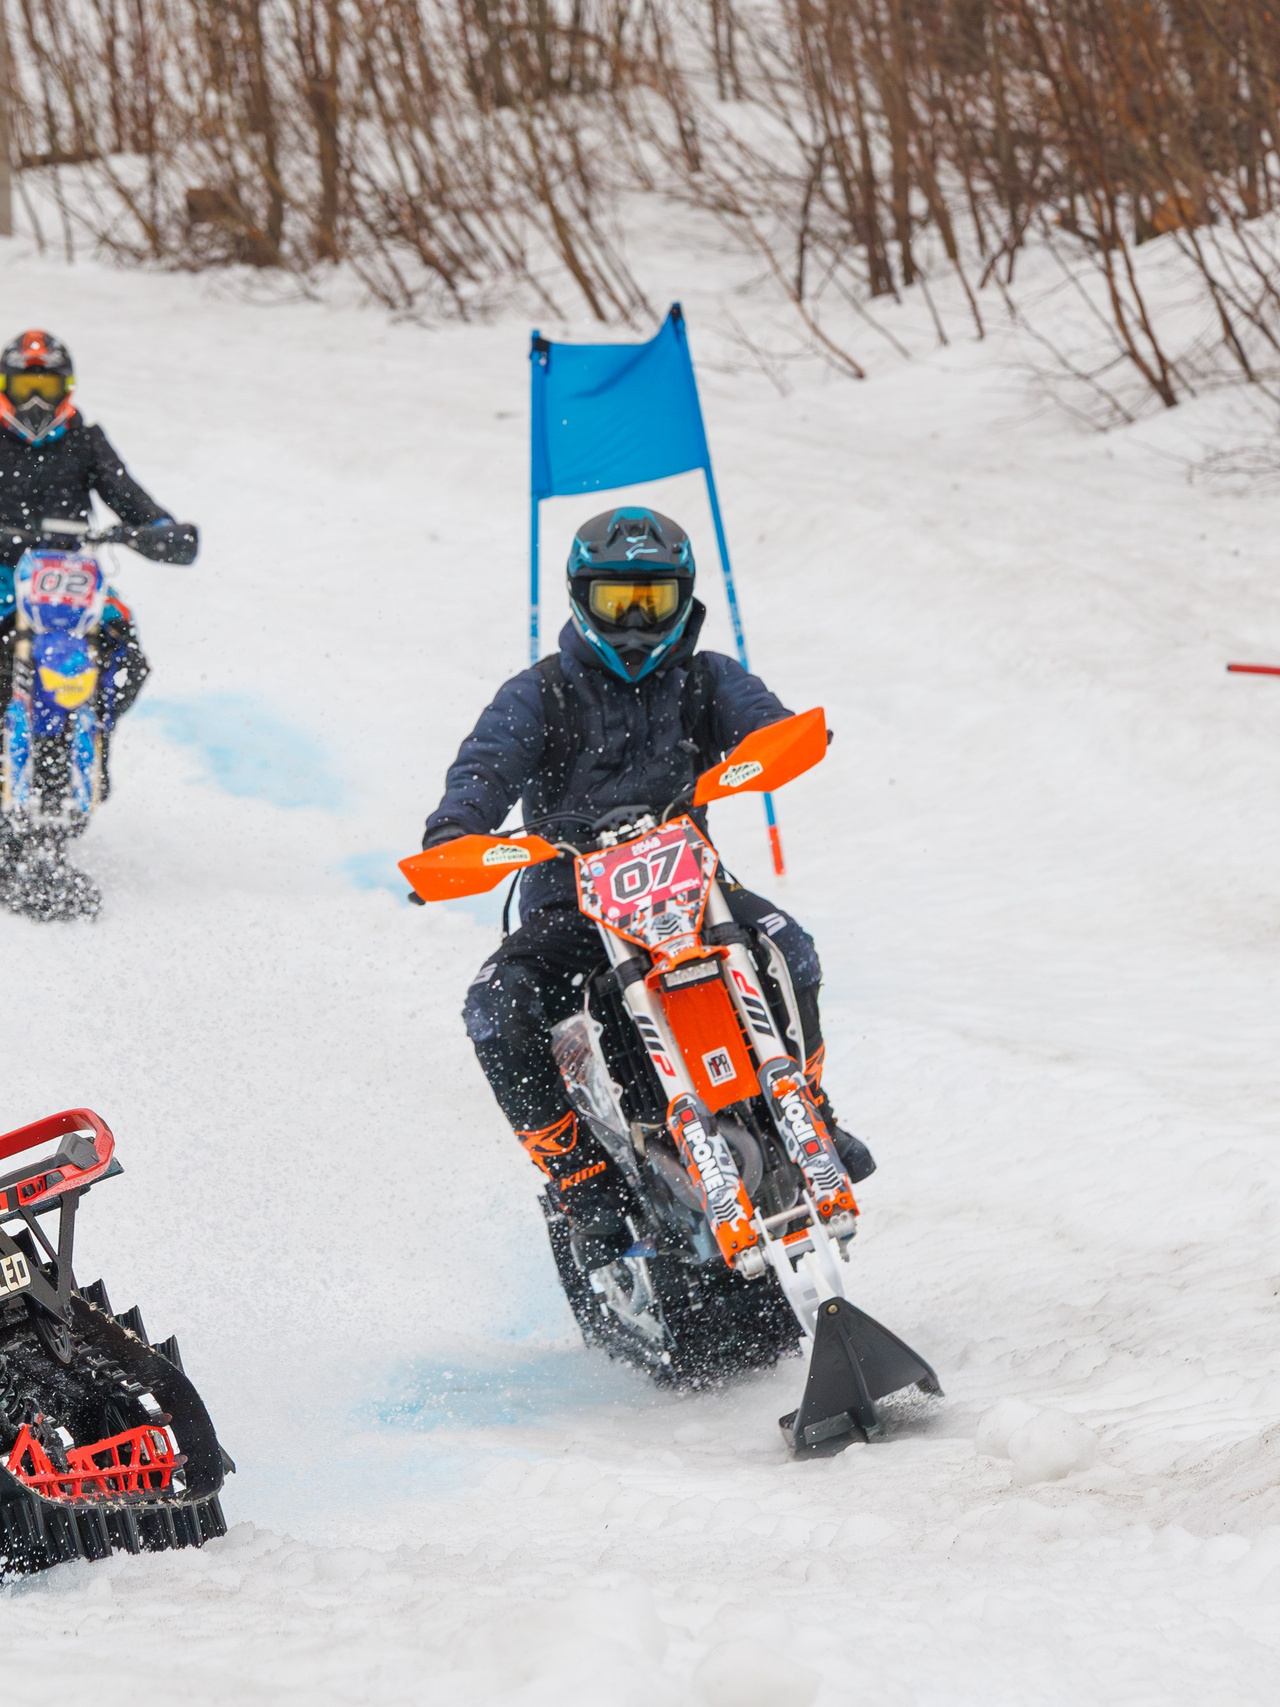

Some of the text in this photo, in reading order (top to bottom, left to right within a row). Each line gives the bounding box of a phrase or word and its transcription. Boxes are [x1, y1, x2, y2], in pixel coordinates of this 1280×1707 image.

[38, 569, 91, 596] 02
[610, 839, 687, 904] 07
[780, 1089, 818, 1143] IPON
[682, 1121, 726, 1194] IPONE
